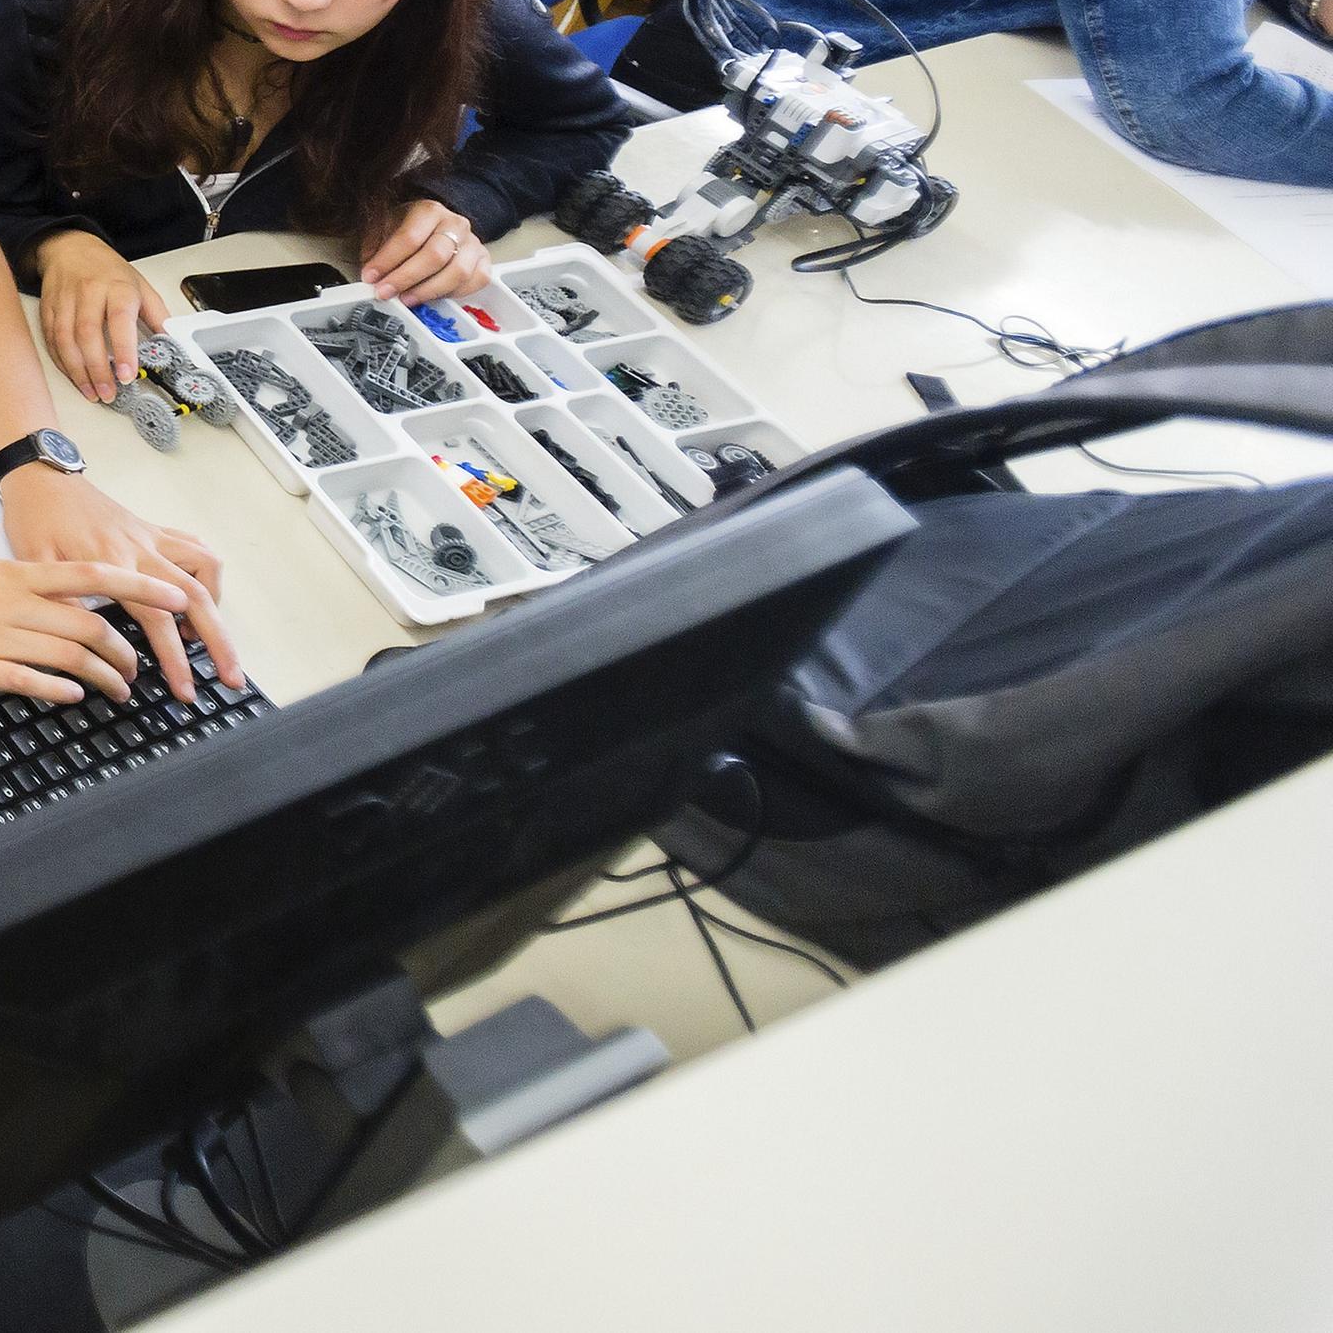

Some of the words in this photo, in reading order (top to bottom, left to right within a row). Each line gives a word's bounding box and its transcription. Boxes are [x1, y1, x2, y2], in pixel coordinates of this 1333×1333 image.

[180, 711, 193, 722] W
[53, 729, 64, 740] H
[132, 732, 144, 742] R
[108, 743, 119, 753] T
[0, 750, 12, 762] K
[56, 765, 67, 776] U
